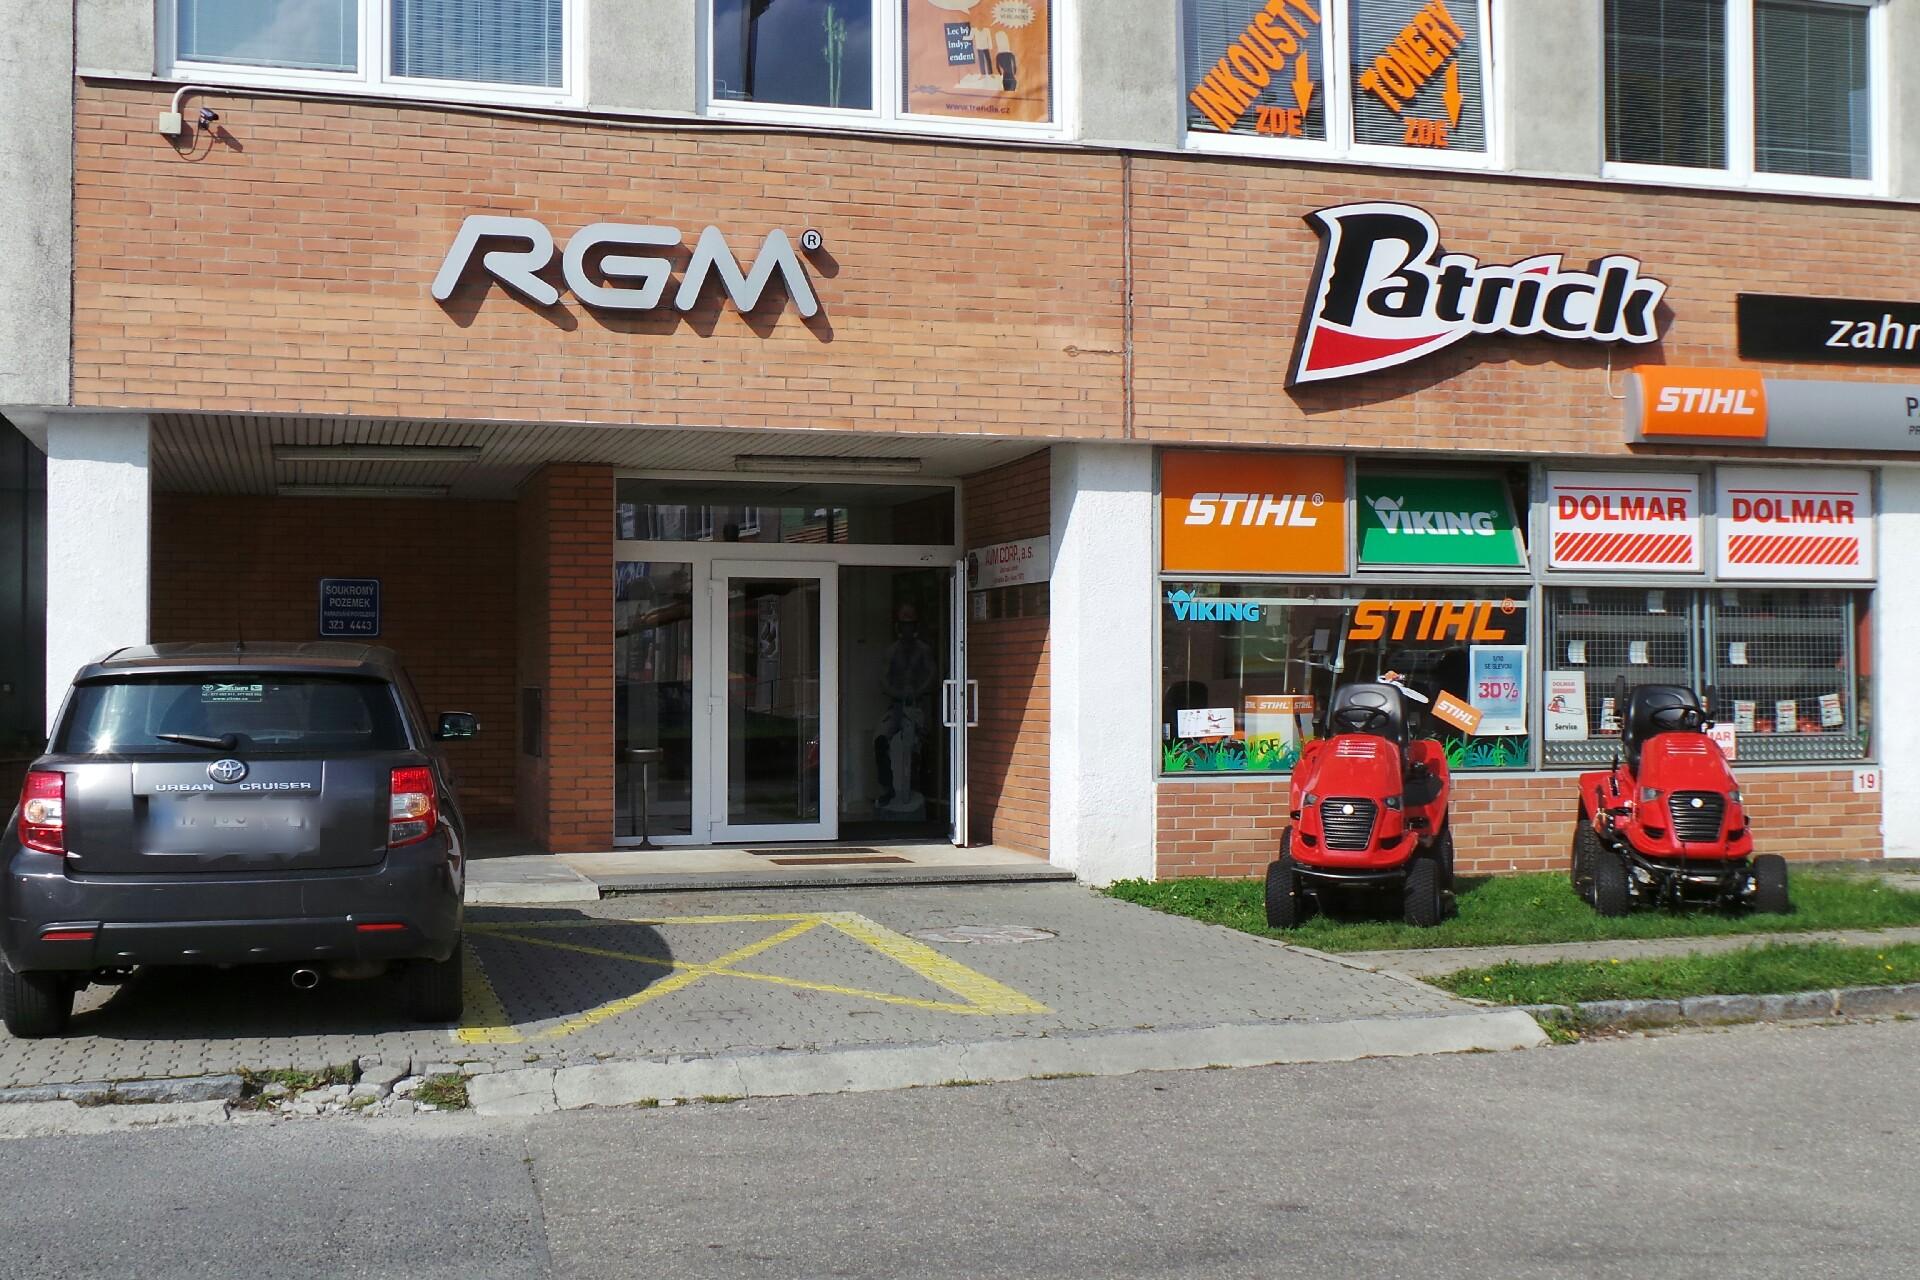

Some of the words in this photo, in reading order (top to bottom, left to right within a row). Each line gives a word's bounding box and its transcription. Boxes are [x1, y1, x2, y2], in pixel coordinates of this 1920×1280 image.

[1358, 0, 1466, 112] TONERY
[1255, 106, 1302, 137] ZDE
[1404, 116, 1449, 146] ZDE
[431, 214, 818, 318] RGM
[1317, 208, 1656, 342] Patrick
[1656, 386, 1756, 416] STIHL
[1184, 492, 1318, 528] STIHL
[1558, 494, 1687, 522] DOLMAR
[1732, 497, 1855, 524] DOLMAR
[1375, 509, 1496, 536] VIKING
[325, 583, 374, 595] SOUKROMÝ
[329, 597, 370, 608] POZEMEK
[1173, 600, 1260, 622] VIKING
[1347, 600, 1506, 641] STIHL
[1478, 682, 1519, 699] 30%
[1259, 701, 1290, 710] STIHL
[1438, 700, 1473, 726] STIHL
[1554, 722, 1578, 731] Service
[155, 783, 214, 791] URBAN
[239, 782, 312, 790] CRUISER
[1858, 774, 1875, 789] 19
